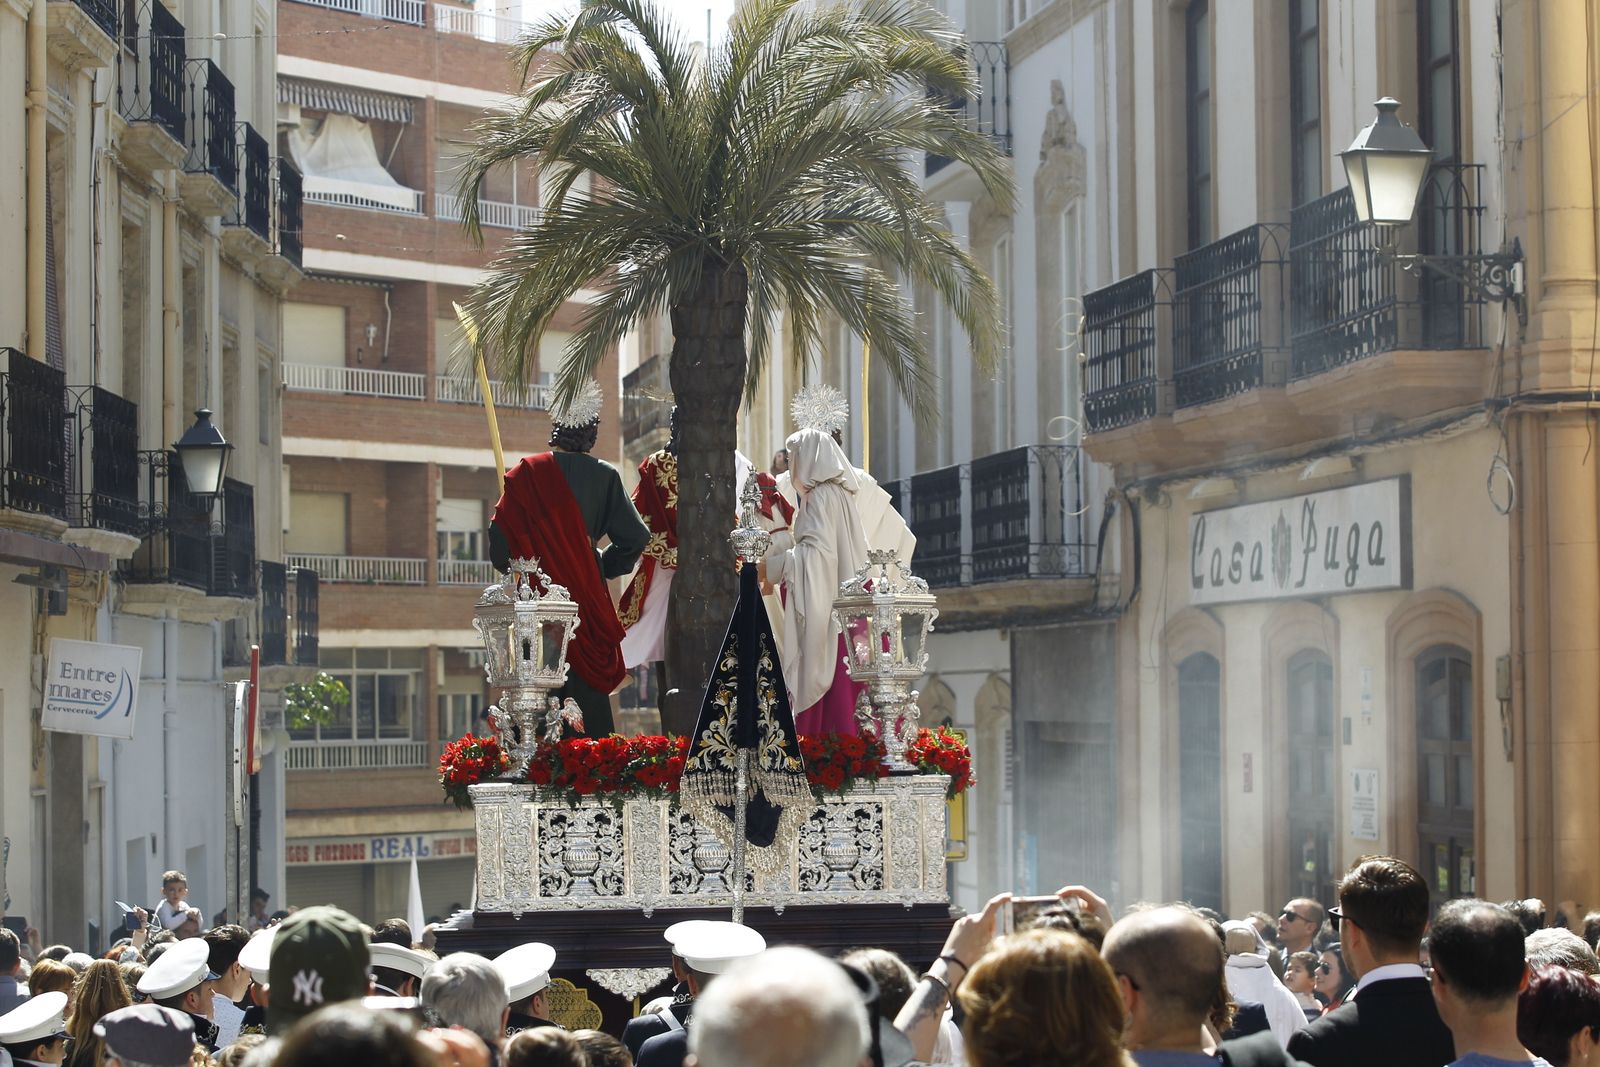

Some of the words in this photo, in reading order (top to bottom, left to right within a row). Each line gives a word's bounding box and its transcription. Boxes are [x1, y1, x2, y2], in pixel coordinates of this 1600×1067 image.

[1191, 514, 1264, 590] Casa
[1294, 497, 1386, 588] Puga
[59, 662, 117, 684] Entre
[48, 683, 113, 702] mares
[371, 836, 430, 859] REAL
[292, 968, 324, 1006] NY
